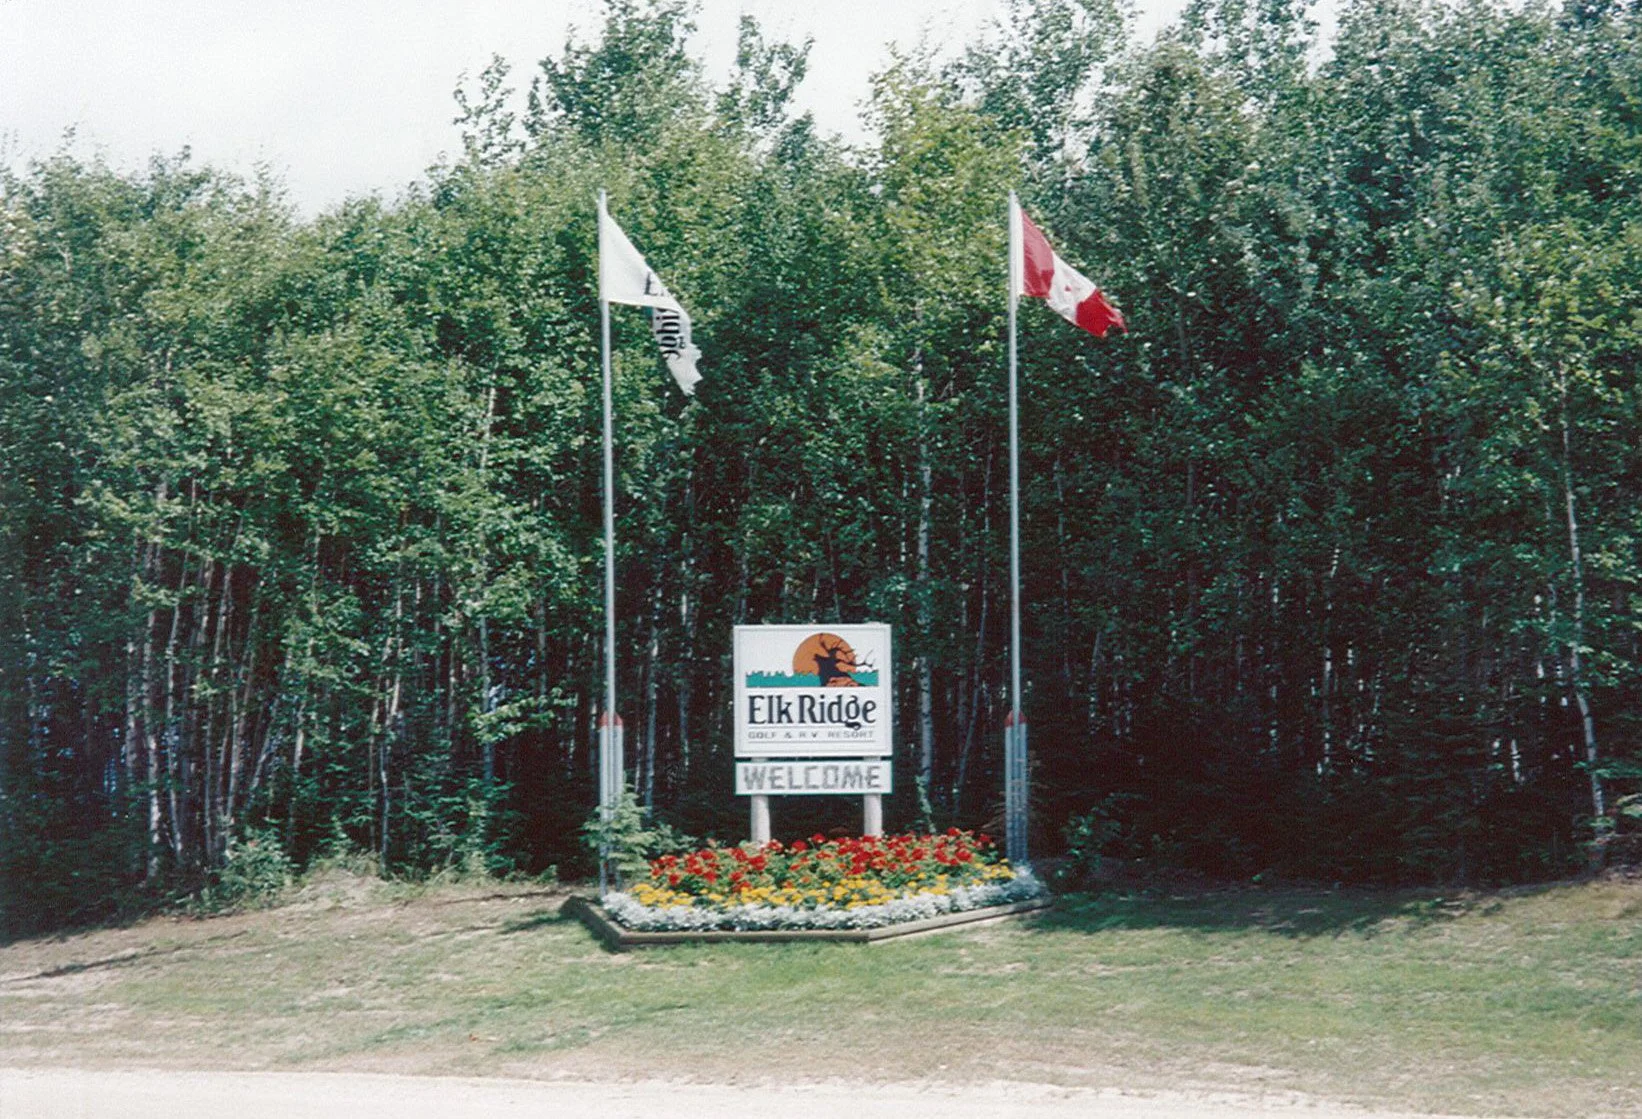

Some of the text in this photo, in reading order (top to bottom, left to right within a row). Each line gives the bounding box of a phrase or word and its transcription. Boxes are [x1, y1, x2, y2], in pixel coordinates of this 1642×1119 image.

[748, 694, 877, 731] Elk Ridge
[748, 731, 776, 740] GOLF
[783, 731, 792, 740] &
[827, 731, 874, 739] RESORT
[744, 765, 882, 790] WELCOME
